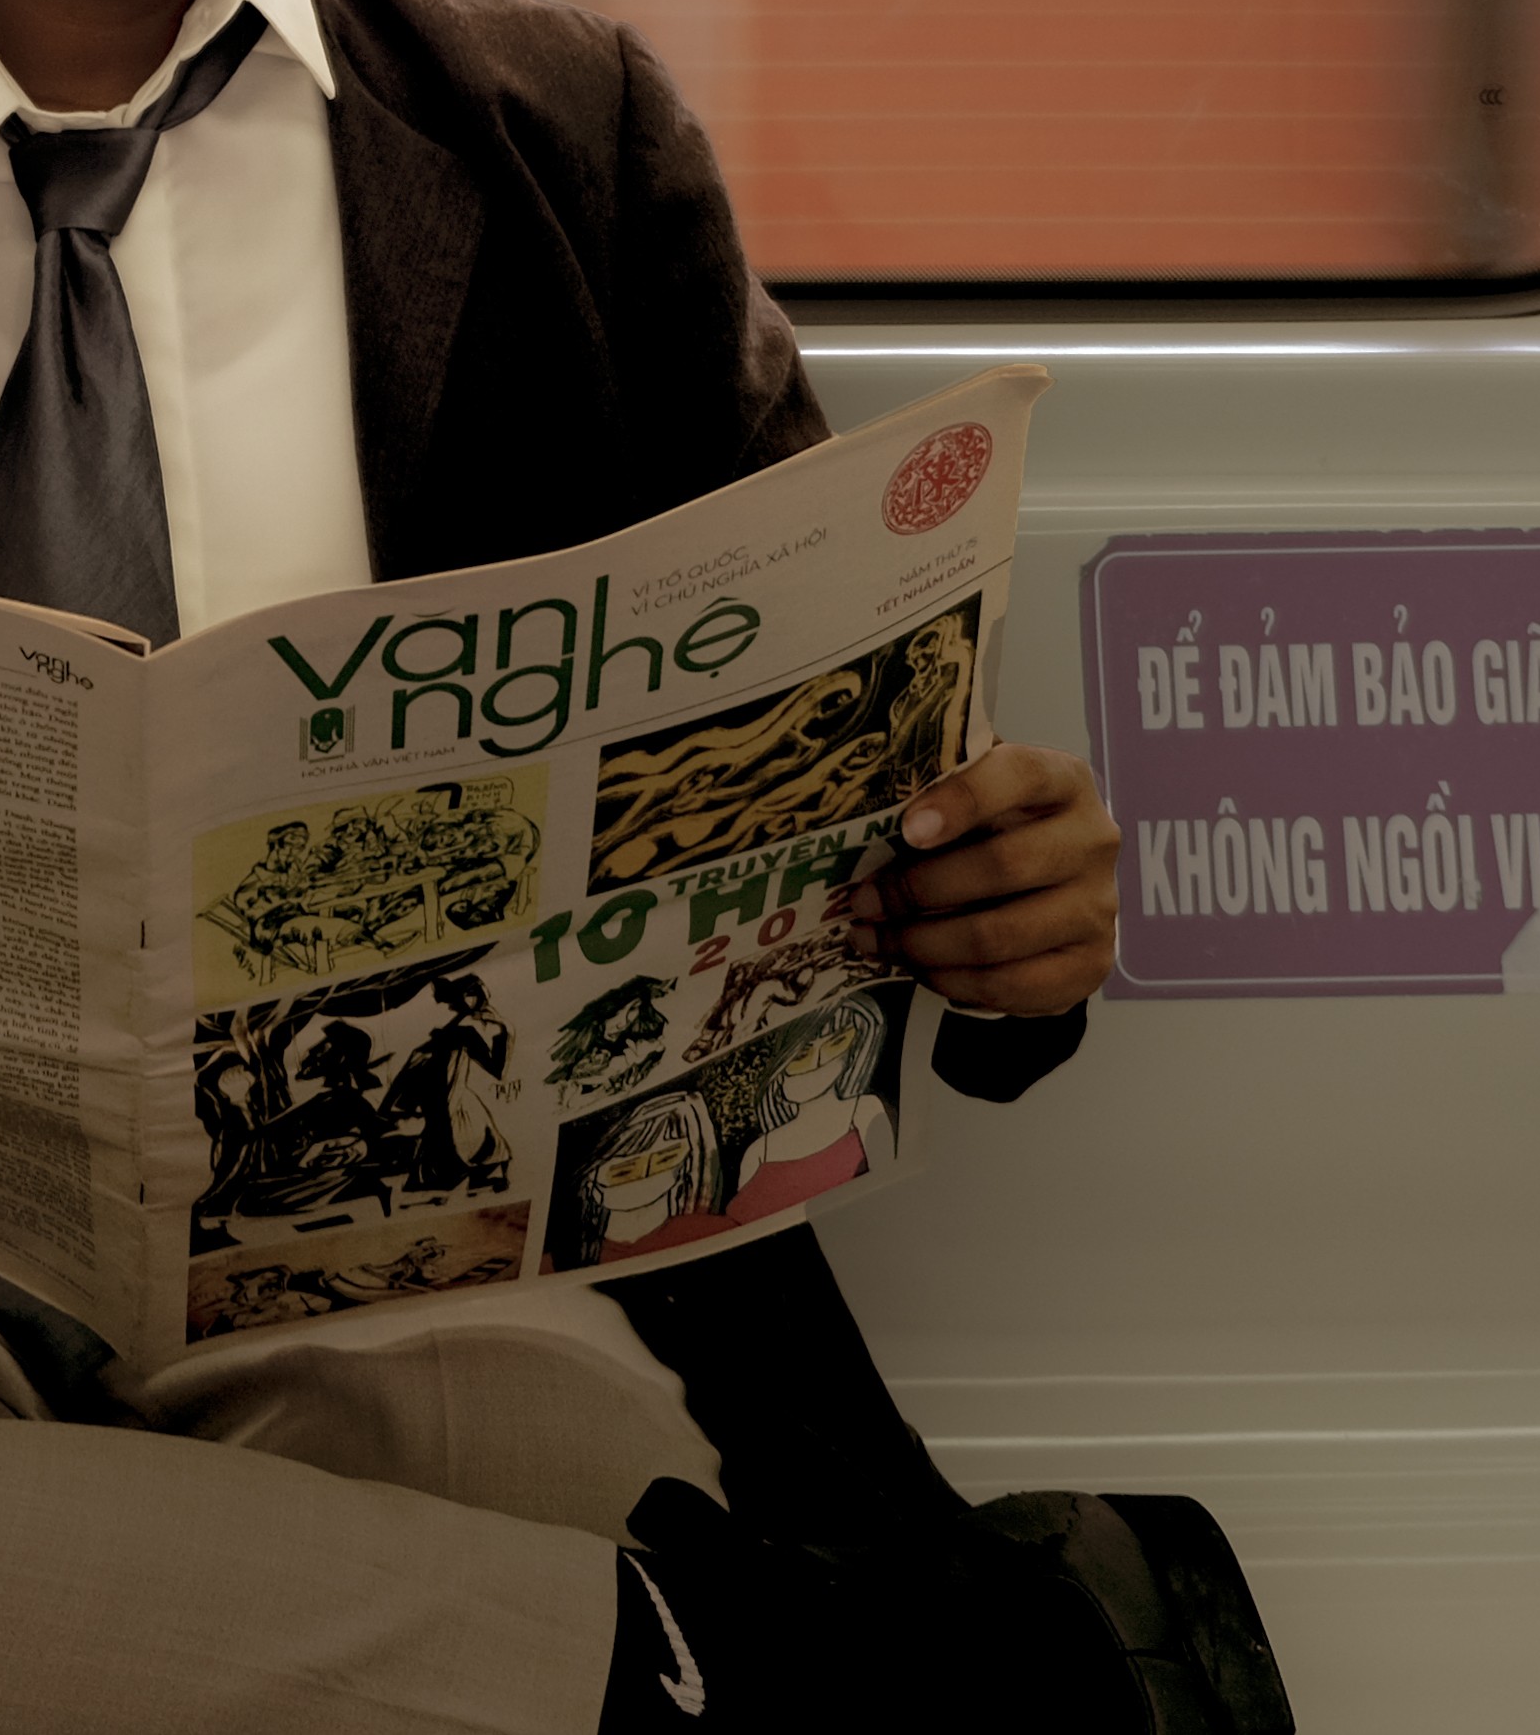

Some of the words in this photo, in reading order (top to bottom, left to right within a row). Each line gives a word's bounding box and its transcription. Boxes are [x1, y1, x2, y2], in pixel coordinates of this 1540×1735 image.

[631, 598, 649, 617] VÌ
[654, 583, 697, 610] CHỦ
[701, 558, 762, 594] NGHĨA
[766, 543, 790, 568] XÃ
[795, 527, 829, 554] HỘI
[632, 580, 650, 599] VÌ
[1138, 609, 1205, 729] ĐỂ
[1220, 606, 1337, 728] ĐẢM
[1353, 605, 1457, 726] BẢO
[863, 813, 900, 841] N
[1138, 797, 1327, 916] KHÔNG
[1344, 780, 1482, 913] NGỒI
[529, 888, 658, 984] 10
